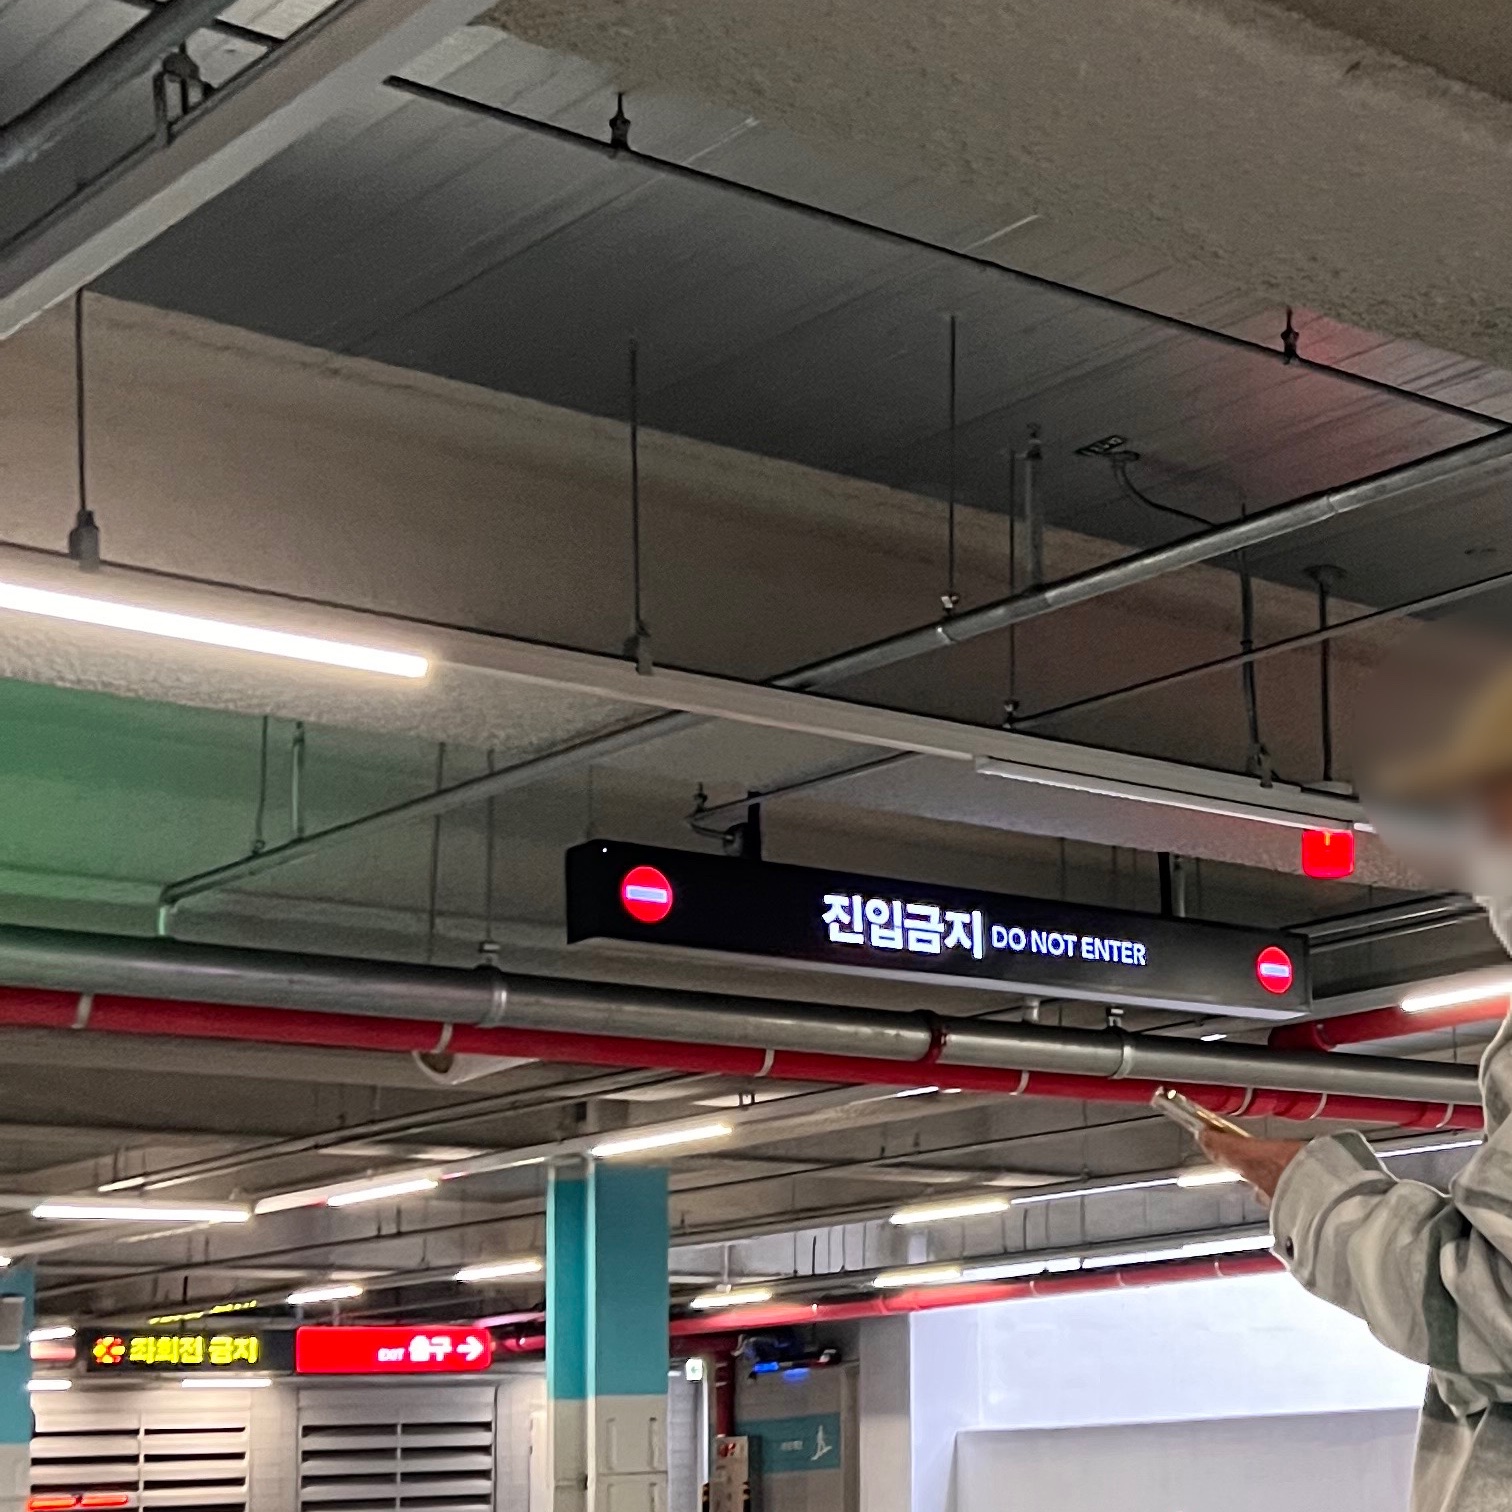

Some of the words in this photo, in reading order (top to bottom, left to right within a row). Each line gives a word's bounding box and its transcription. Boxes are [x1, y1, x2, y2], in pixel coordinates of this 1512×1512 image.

[822, 893, 983, 960] 진입금지
[991, 924, 1025, 951] DO
[1031, 930, 1078, 957] NOT
[1081, 935, 1147, 966] ENTER
[208, 1336, 259, 1364] 금지
